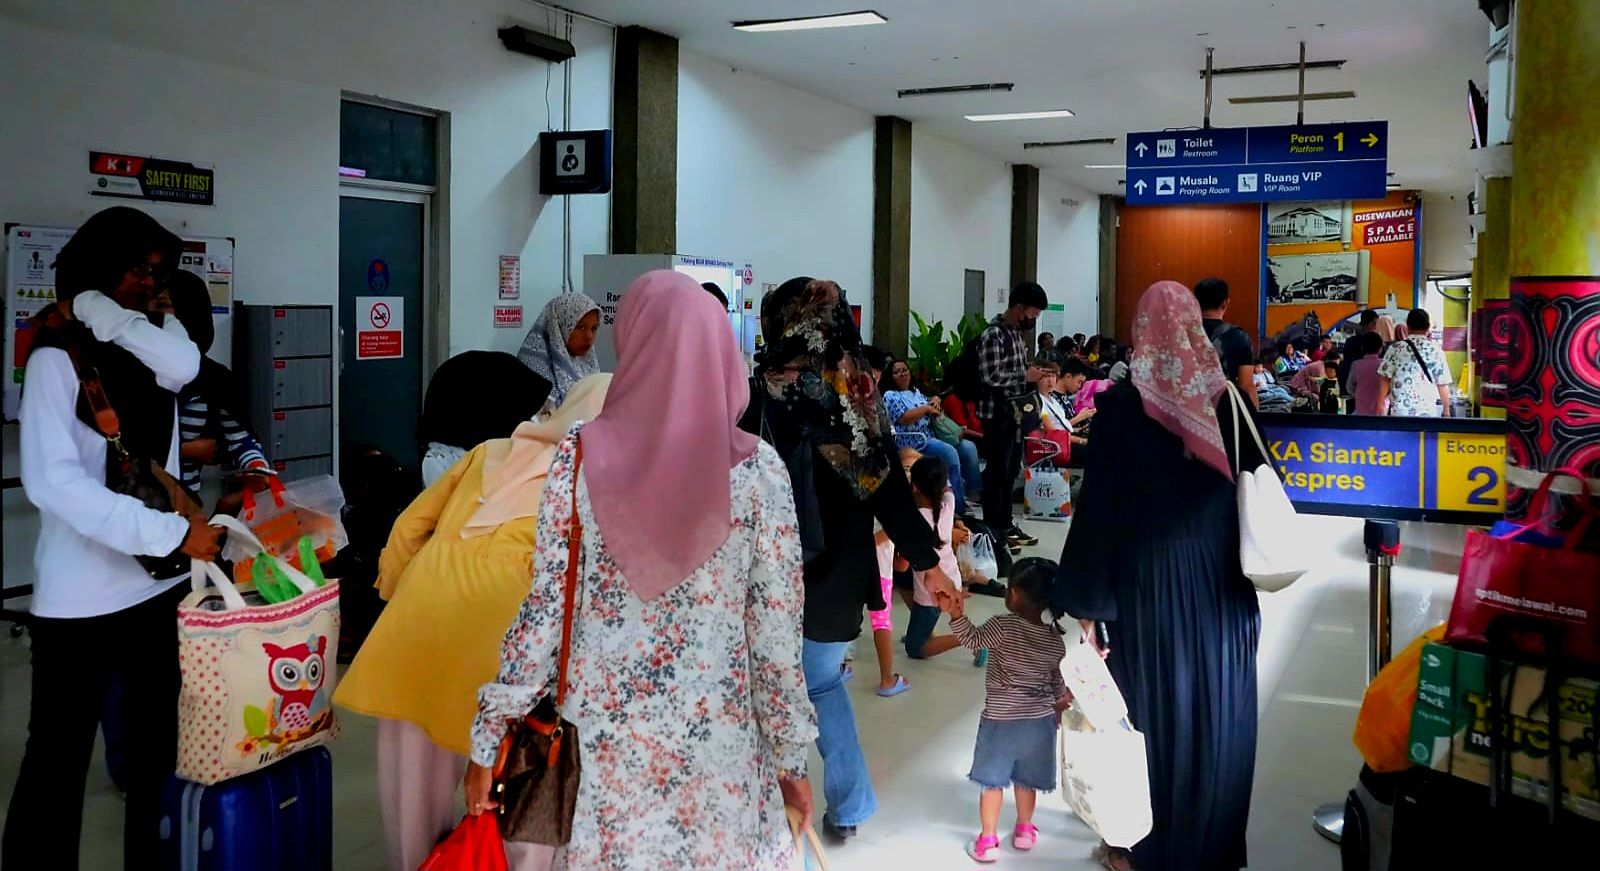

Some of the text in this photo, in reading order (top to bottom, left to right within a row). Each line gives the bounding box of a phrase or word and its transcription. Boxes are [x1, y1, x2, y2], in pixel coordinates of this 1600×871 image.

[1183, 138, 1213, 148] Toilet
[1290, 132, 1344, 152] Peron 1
[1183, 150, 1218, 158] Restroom
[1290, 145, 1324, 153] Platform
[146, 169, 181, 188] SAFETY
[184, 173, 210, 192] FIRST
[1180, 175, 1218, 186] Musala
[1264, 171, 1322, 184] Ruang VIP
[1179, 187, 1230, 196] Praying Room
[1264, 185, 1277, 193] VIP
[1355, 209, 1413, 222] DISEWAKAN
[1367, 222, 1414, 236] SPACE
[1367, 232, 1414, 244] AVAILABLE
[1268, 440, 1406, 466] KA Siantar
[1280, 466, 1366, 493] kspres
[1467, 465, 1499, 506] 2
[1420, 679, 1450, 697] Small
